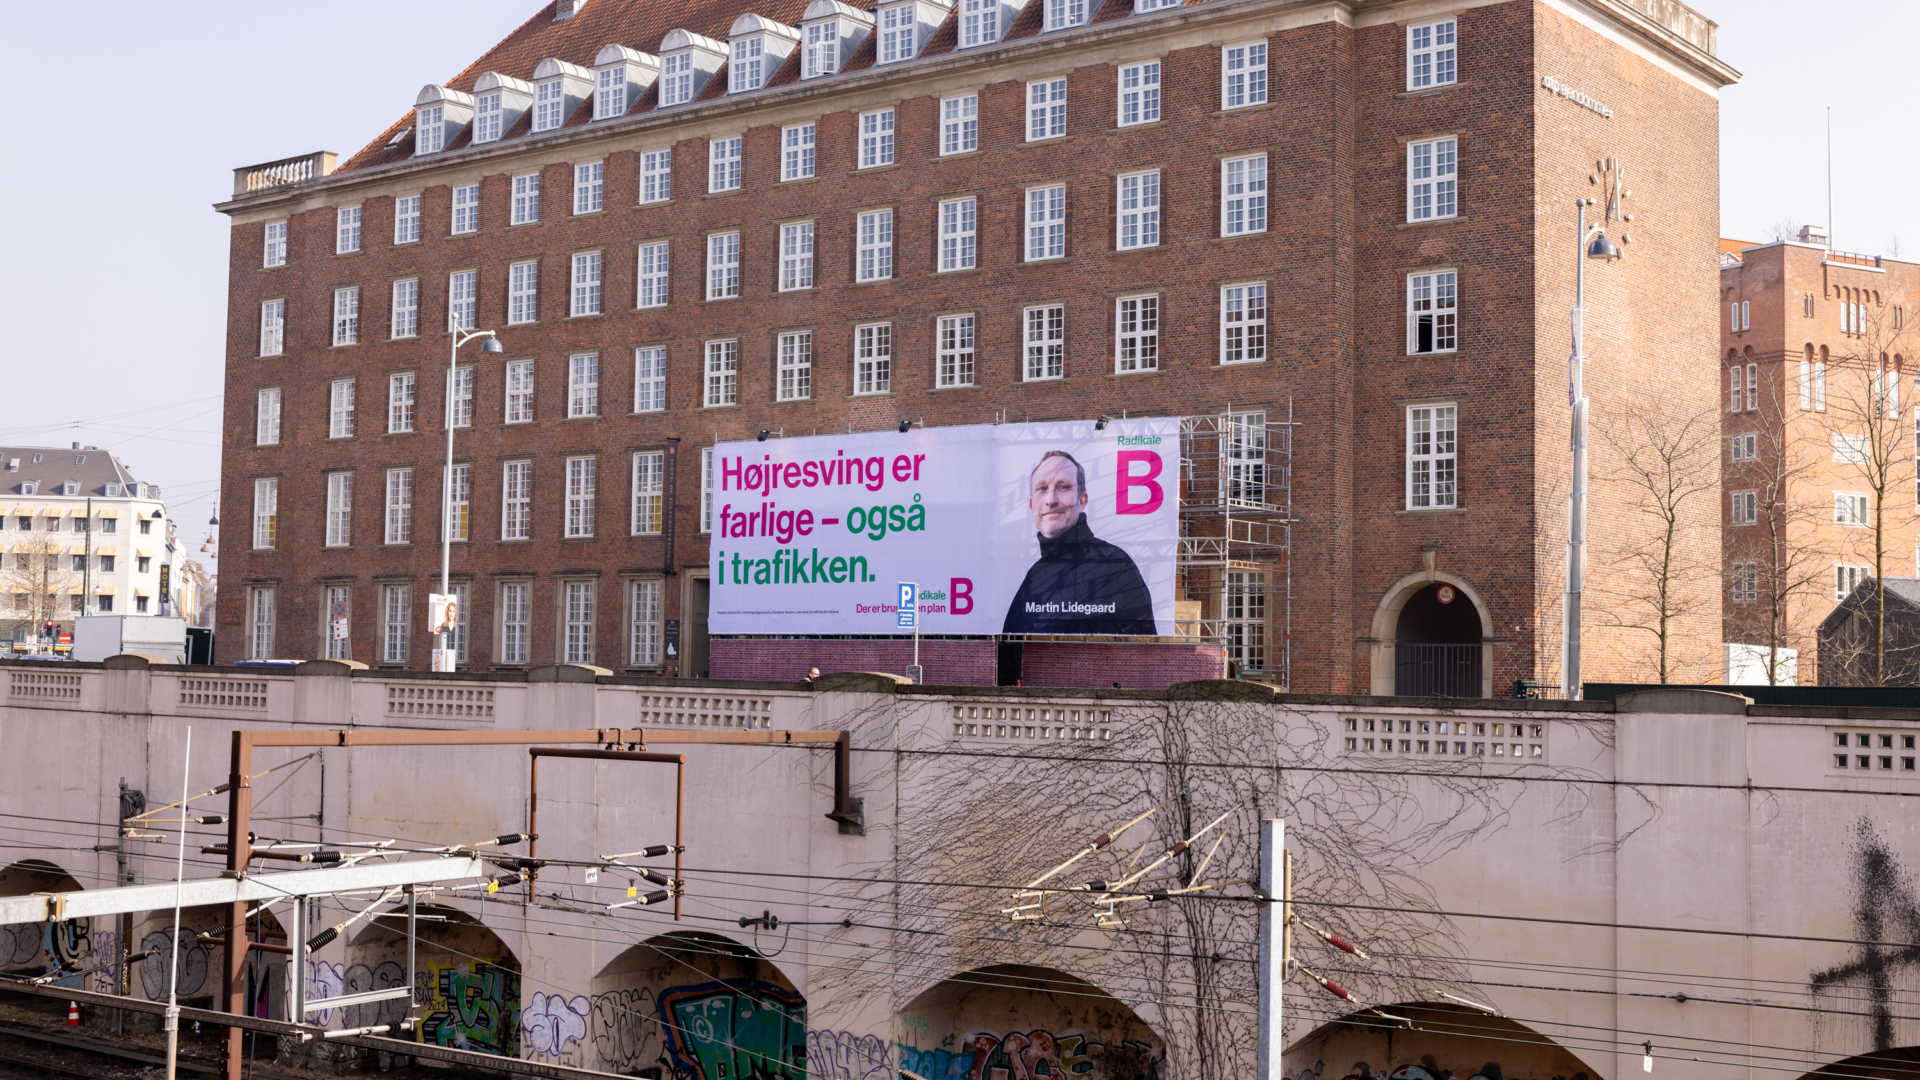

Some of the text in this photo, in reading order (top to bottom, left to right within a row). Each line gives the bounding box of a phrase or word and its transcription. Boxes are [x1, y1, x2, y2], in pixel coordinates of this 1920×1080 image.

[1117, 435, 1162, 446] Radikale
[721, 449, 926, 498] Højresving er
[1116, 450, 1164, 515] B
[719, 501, 815, 545] farlige
[846, 492, 926, 541] også
[718, 547, 876, 585] i trafikken.
[856, 603, 870, 613] Der
[871, 605, 881, 613] er
[927, 603, 946, 615] plan
[902, 586, 912, 607] P
[950, 578, 974, 614] B
[1025, 601, 1116, 615] Martin Lidegaard
